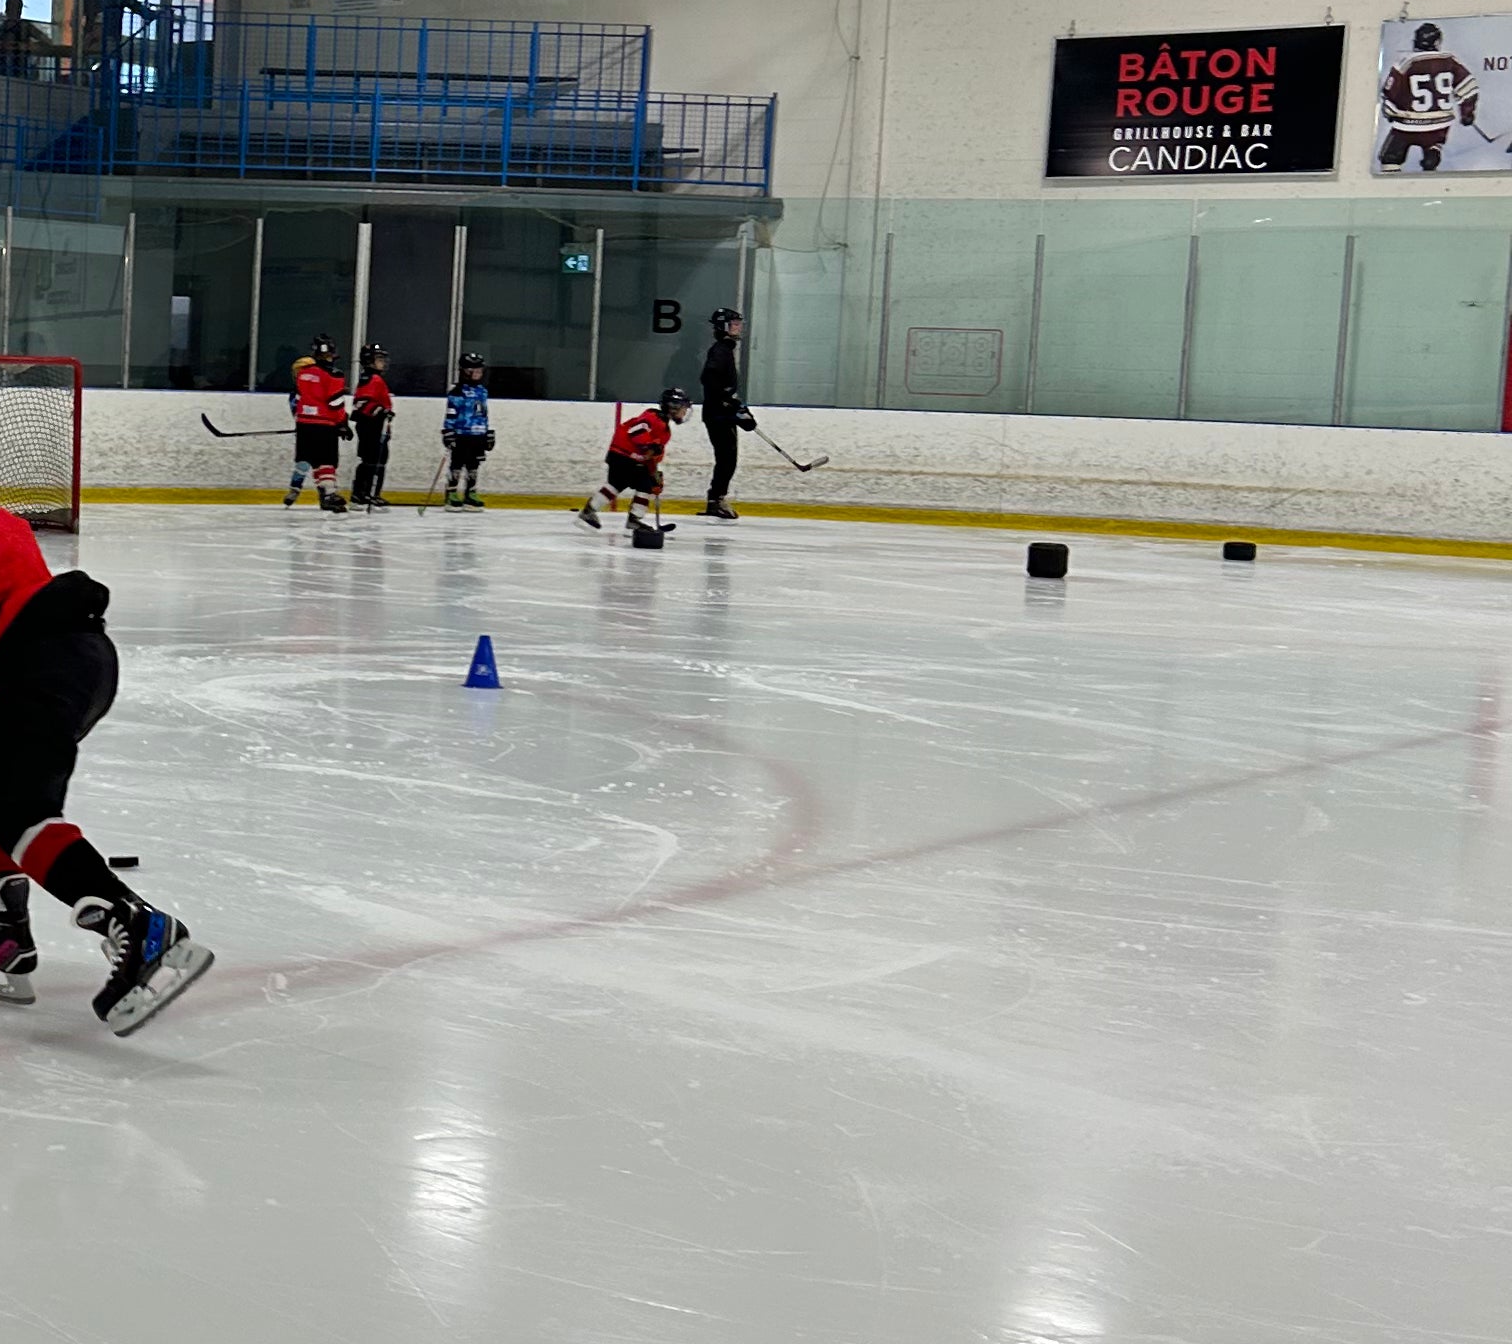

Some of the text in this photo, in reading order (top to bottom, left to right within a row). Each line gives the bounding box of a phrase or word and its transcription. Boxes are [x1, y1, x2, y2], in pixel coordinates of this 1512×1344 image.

[1118, 42, 1277, 82] BÂTON
[1483, 56, 1512, 71] NO
[1115, 83, 1275, 118] ROUGE
[1409, 72, 1455, 112] 59
[1112, 123, 1273, 141] GRILLHOUSE & BAR
[1108, 143, 1269, 172] CANDIAC
[653, 299, 682, 334] B
